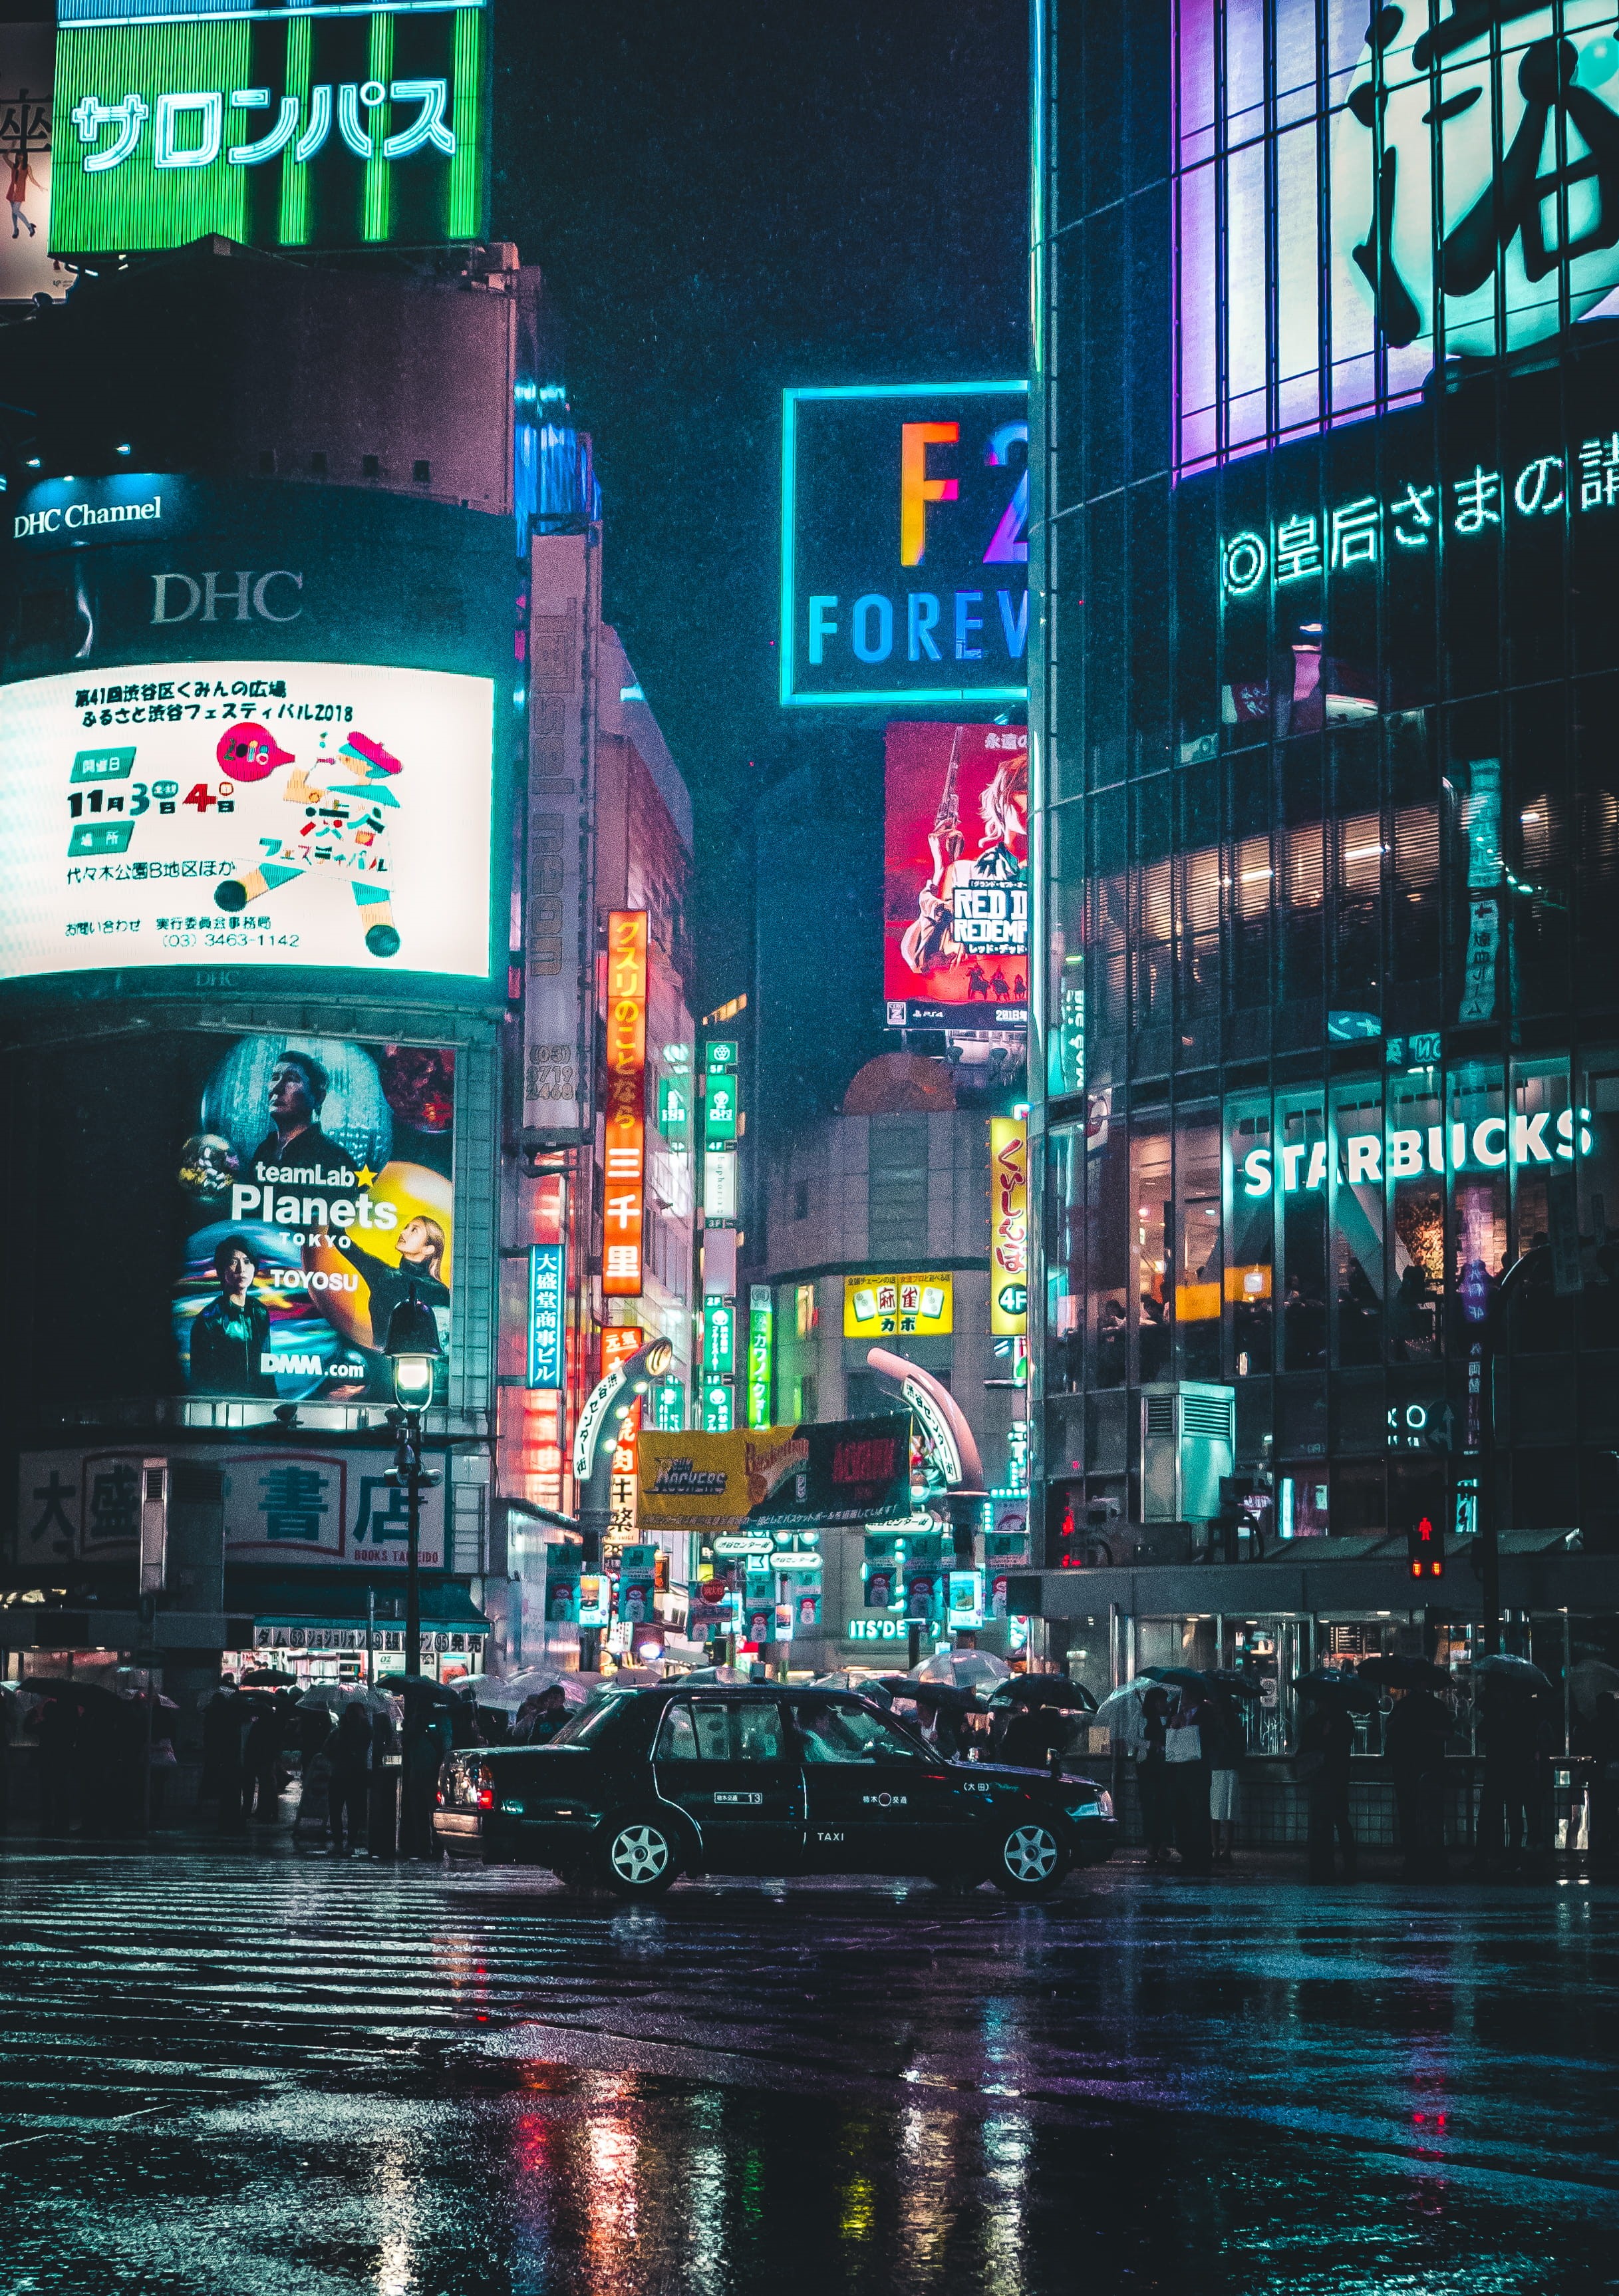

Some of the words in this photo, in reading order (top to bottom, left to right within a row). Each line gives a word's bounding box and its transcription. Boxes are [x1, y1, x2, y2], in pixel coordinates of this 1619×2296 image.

[71, 78, 457, 173] サロンパス
[13, 508, 61, 539] DHC
[65, 496, 162, 528] Channel
[150, 570, 303, 625] DHC
[75, 681, 287, 707] 第41回渋谷区くみんの広場
[67, 860, 237, 885] 代々木公園B地区ほか
[954, 889, 1006, 919] RED
[65, 919, 142, 937] お問い合わせ
[162, 934, 197, 948] (03)
[204, 933, 301, 948] 3463-1142
[194, 969, 239, 987] DHC
[615, 921, 640, 1130] クスリのことなら
[708, 1142, 723, 1150] 4F
[1243, 1107, 1593, 1197] STARBUCKS
[255, 1160, 355, 1188] teamLab
[231, 1184, 398, 1230] Planets
[605, 1148, 641, 1277] 三千里
[279, 1231, 352, 1249] TOKYO
[269, 1269, 359, 1293] TOYOSU
[706, 1297, 721, 1307] 2F
[879, 1286, 918, 1309] 麻雀
[1000, 1287, 1028, 1311] 4F
[535, 1253, 558, 1381] 大盛堂商事ビル
[881, 1316, 917, 1332] カボ
[260, 1353, 365, 1379] DMM.com
[706, 1375, 720, 1385] 1F
[576, 1372, 619, 1475] 渋谷センター街
[31, 1464, 432, 1545] 大盛書店
[867, 1518, 929, 1528] センター街
[354, 1549, 388, 1561] BOOKS
[392, 1550, 439, 1563] TAEIDO
[718, 1540, 770, 1550] 渋谷センター街
[849, 1619, 941, 1640] ITS'DE
[748, 1793, 761, 1803] 13
[963, 1782, 990, 1792] (大田)
[817, 1832, 845, 1842] TAXI
